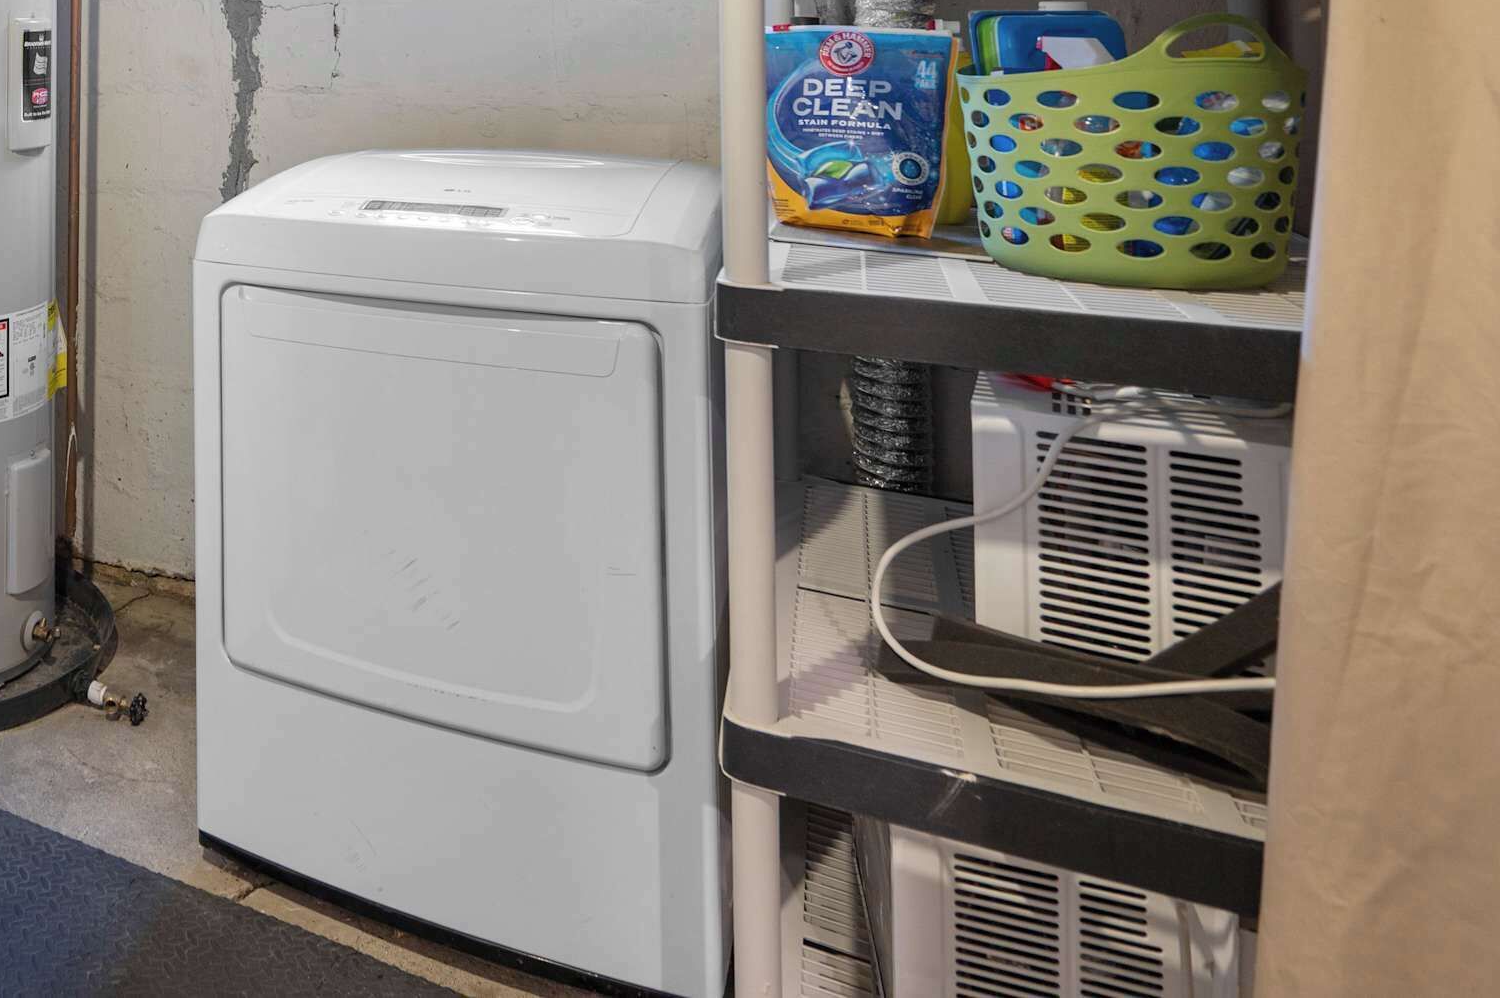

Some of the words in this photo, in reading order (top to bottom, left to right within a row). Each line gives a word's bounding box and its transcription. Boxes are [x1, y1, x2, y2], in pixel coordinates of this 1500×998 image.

[916, 60, 936, 77] 44
[803, 78, 892, 98] DEEP
[792, 97, 903, 120] CLEAN
[831, 120, 891, 130] FORMULA
